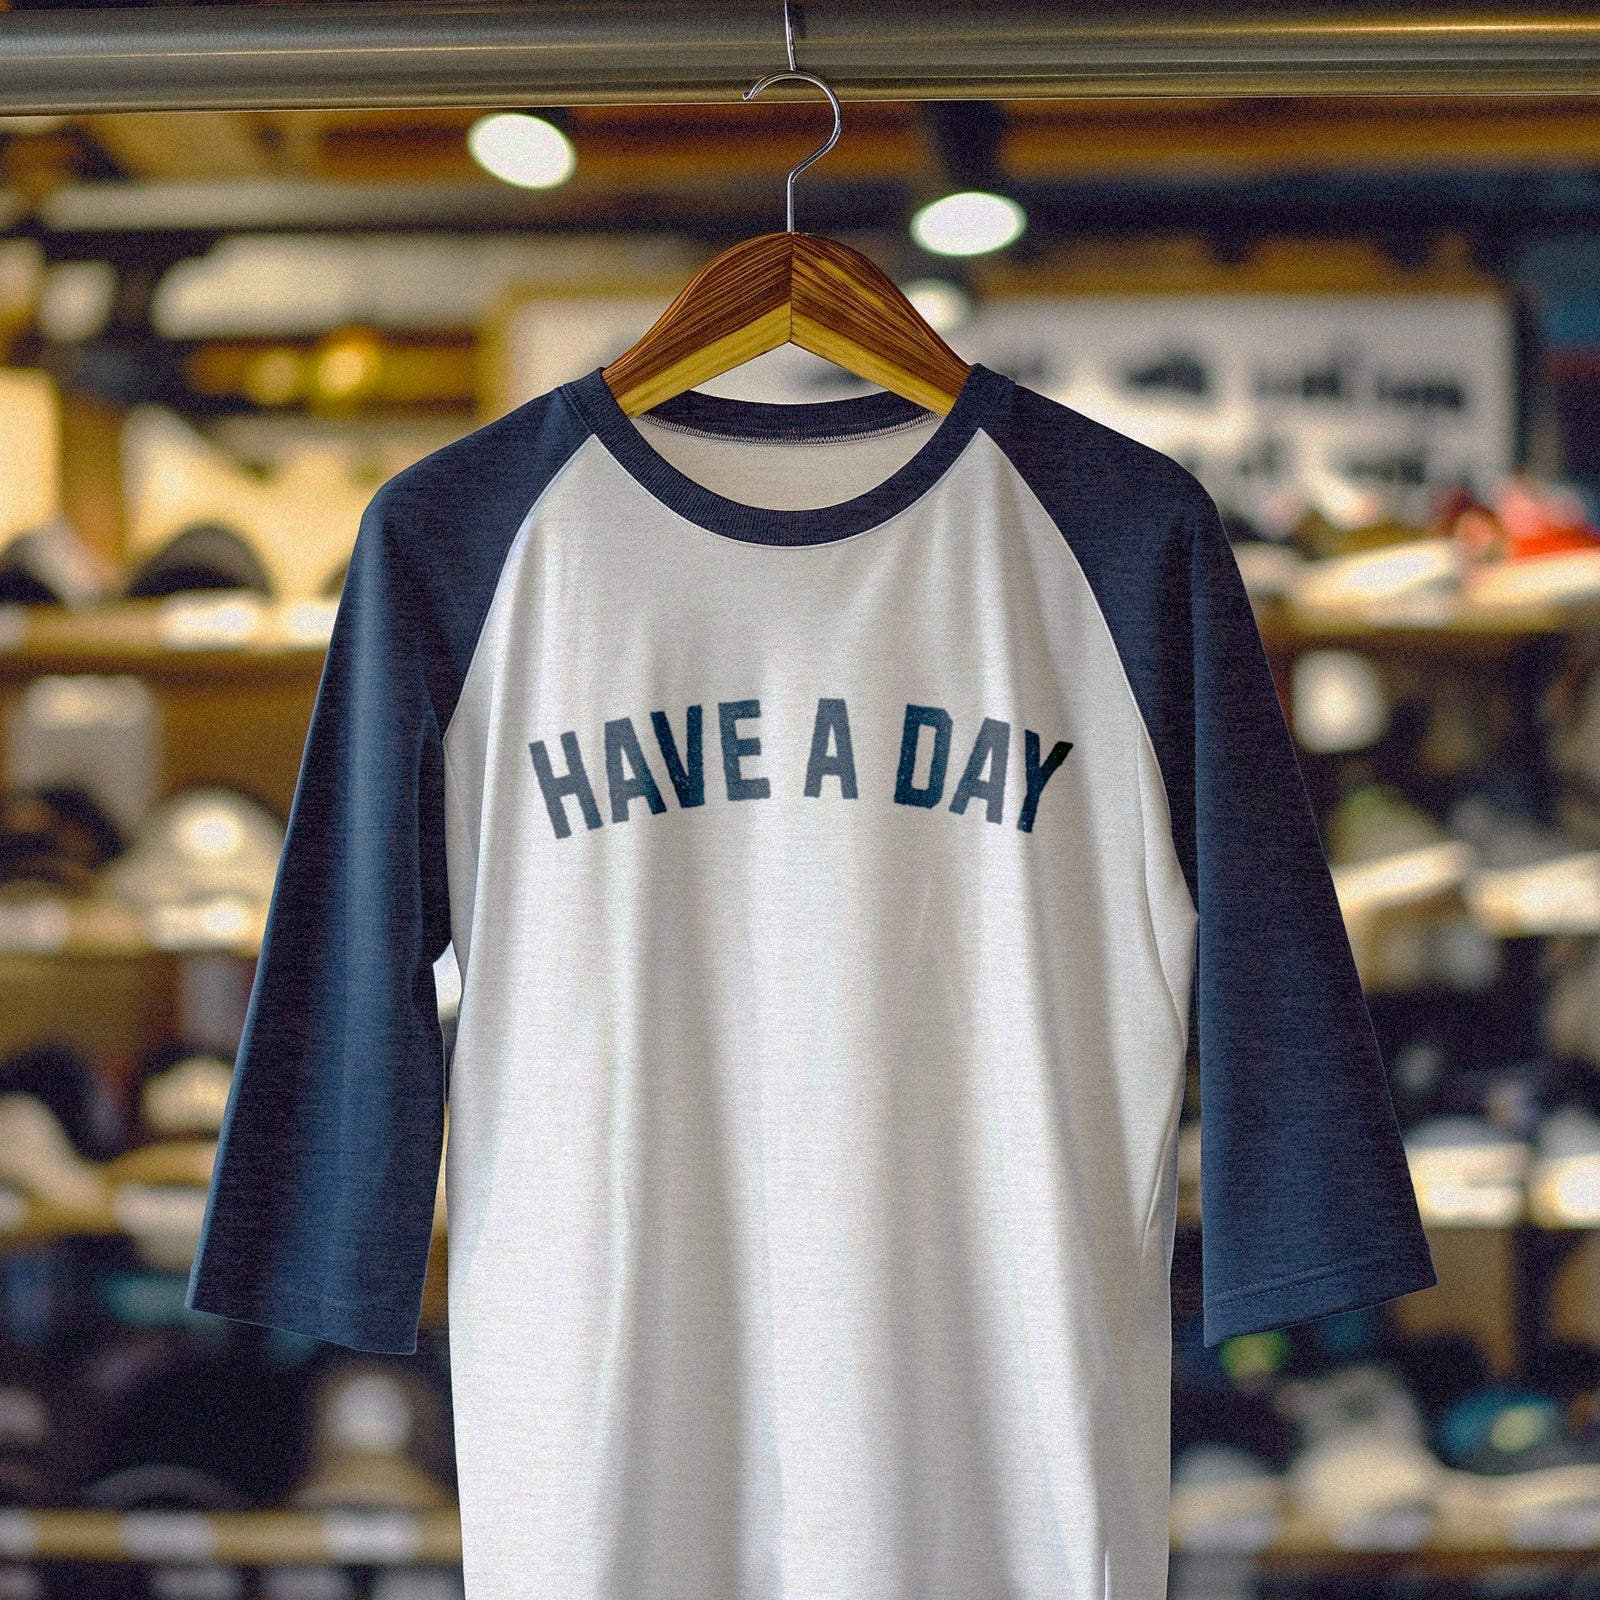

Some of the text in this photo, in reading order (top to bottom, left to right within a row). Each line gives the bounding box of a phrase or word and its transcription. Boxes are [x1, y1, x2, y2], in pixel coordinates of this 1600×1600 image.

[528, 698, 1074, 839] HAVE A DAY
